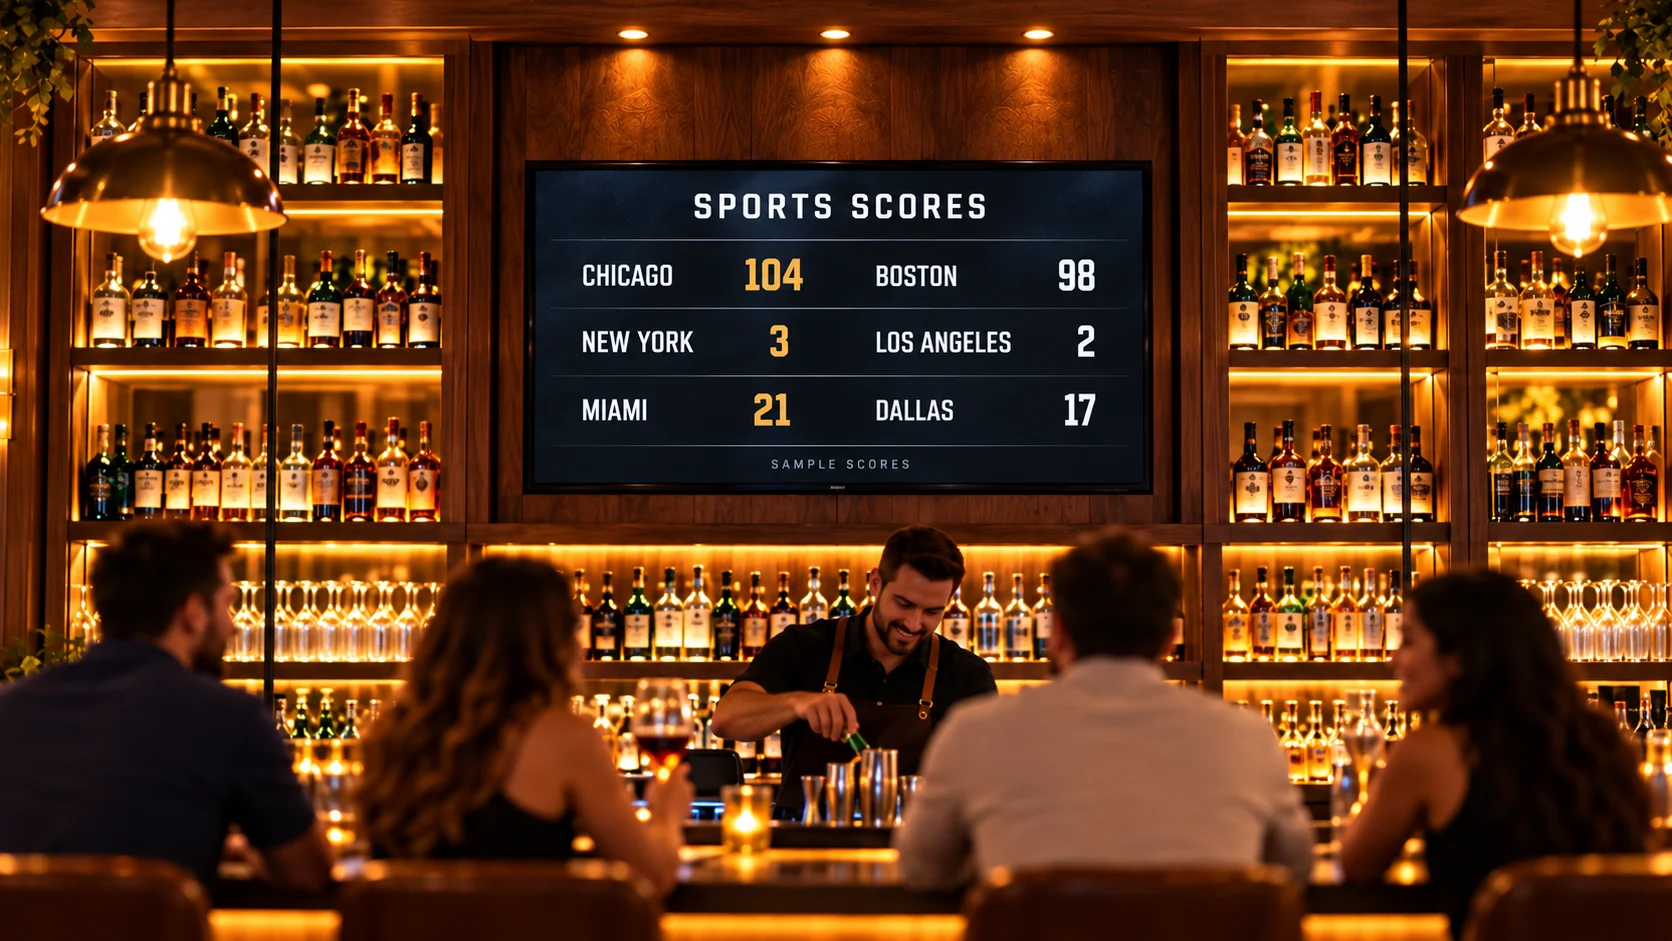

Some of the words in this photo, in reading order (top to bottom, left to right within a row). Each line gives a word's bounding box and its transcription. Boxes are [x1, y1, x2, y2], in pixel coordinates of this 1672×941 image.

[694, 193, 831, 219] SPORTS
[852, 194, 985, 219] SCORES
[583, 264, 672, 286] CHICAGO
[745, 258, 803, 291] 104
[876, 265, 956, 286] BOSTON
[1059, 259, 1095, 291] 98
[583, 331, 630, 352] NEW
[638, 331, 693, 353] YORK
[770, 325, 788, 357] 3
[877, 331, 913, 353] LOS
[920, 331, 1011, 353] ANGELES
[1078, 325, 1095, 357] 2
[583, 399, 646, 421] MIAMI
[754, 393, 790, 426] 21
[876, 400, 953, 421] DALLAS
[1065, 393, 1096, 426] 17
[771, 458, 836, 470] SAMPLE
[846, 458, 910, 470] SCORES
